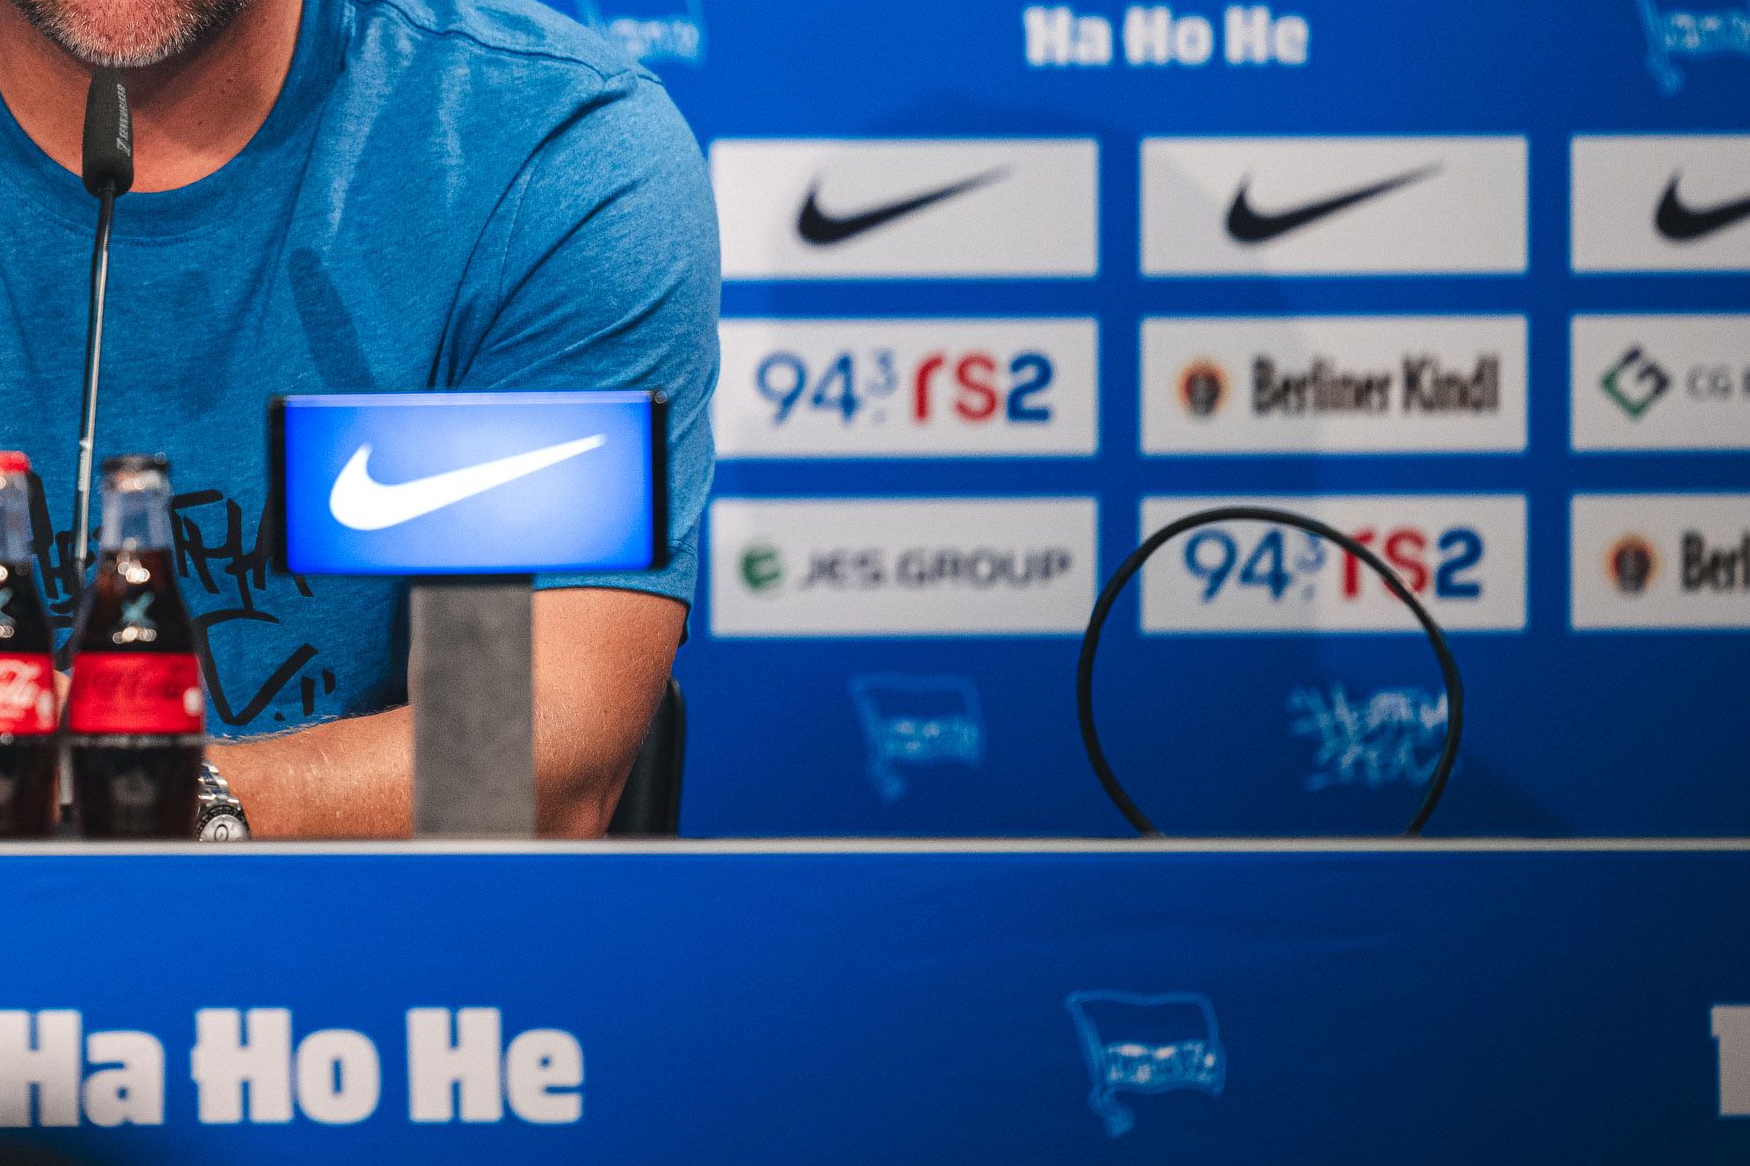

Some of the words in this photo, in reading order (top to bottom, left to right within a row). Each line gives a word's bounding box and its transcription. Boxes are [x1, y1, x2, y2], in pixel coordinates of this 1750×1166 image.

[1023, 5, 1113, 66] Ha
[1122, 5, 1214, 66] Ho
[1223, 5, 1310, 65] He
[1249, 353, 1394, 419] Berliner
[1401, 353, 1502, 417] Kindl
[190, 1007, 381, 1126] Ho
[406, 1006, 584, 1124] He
